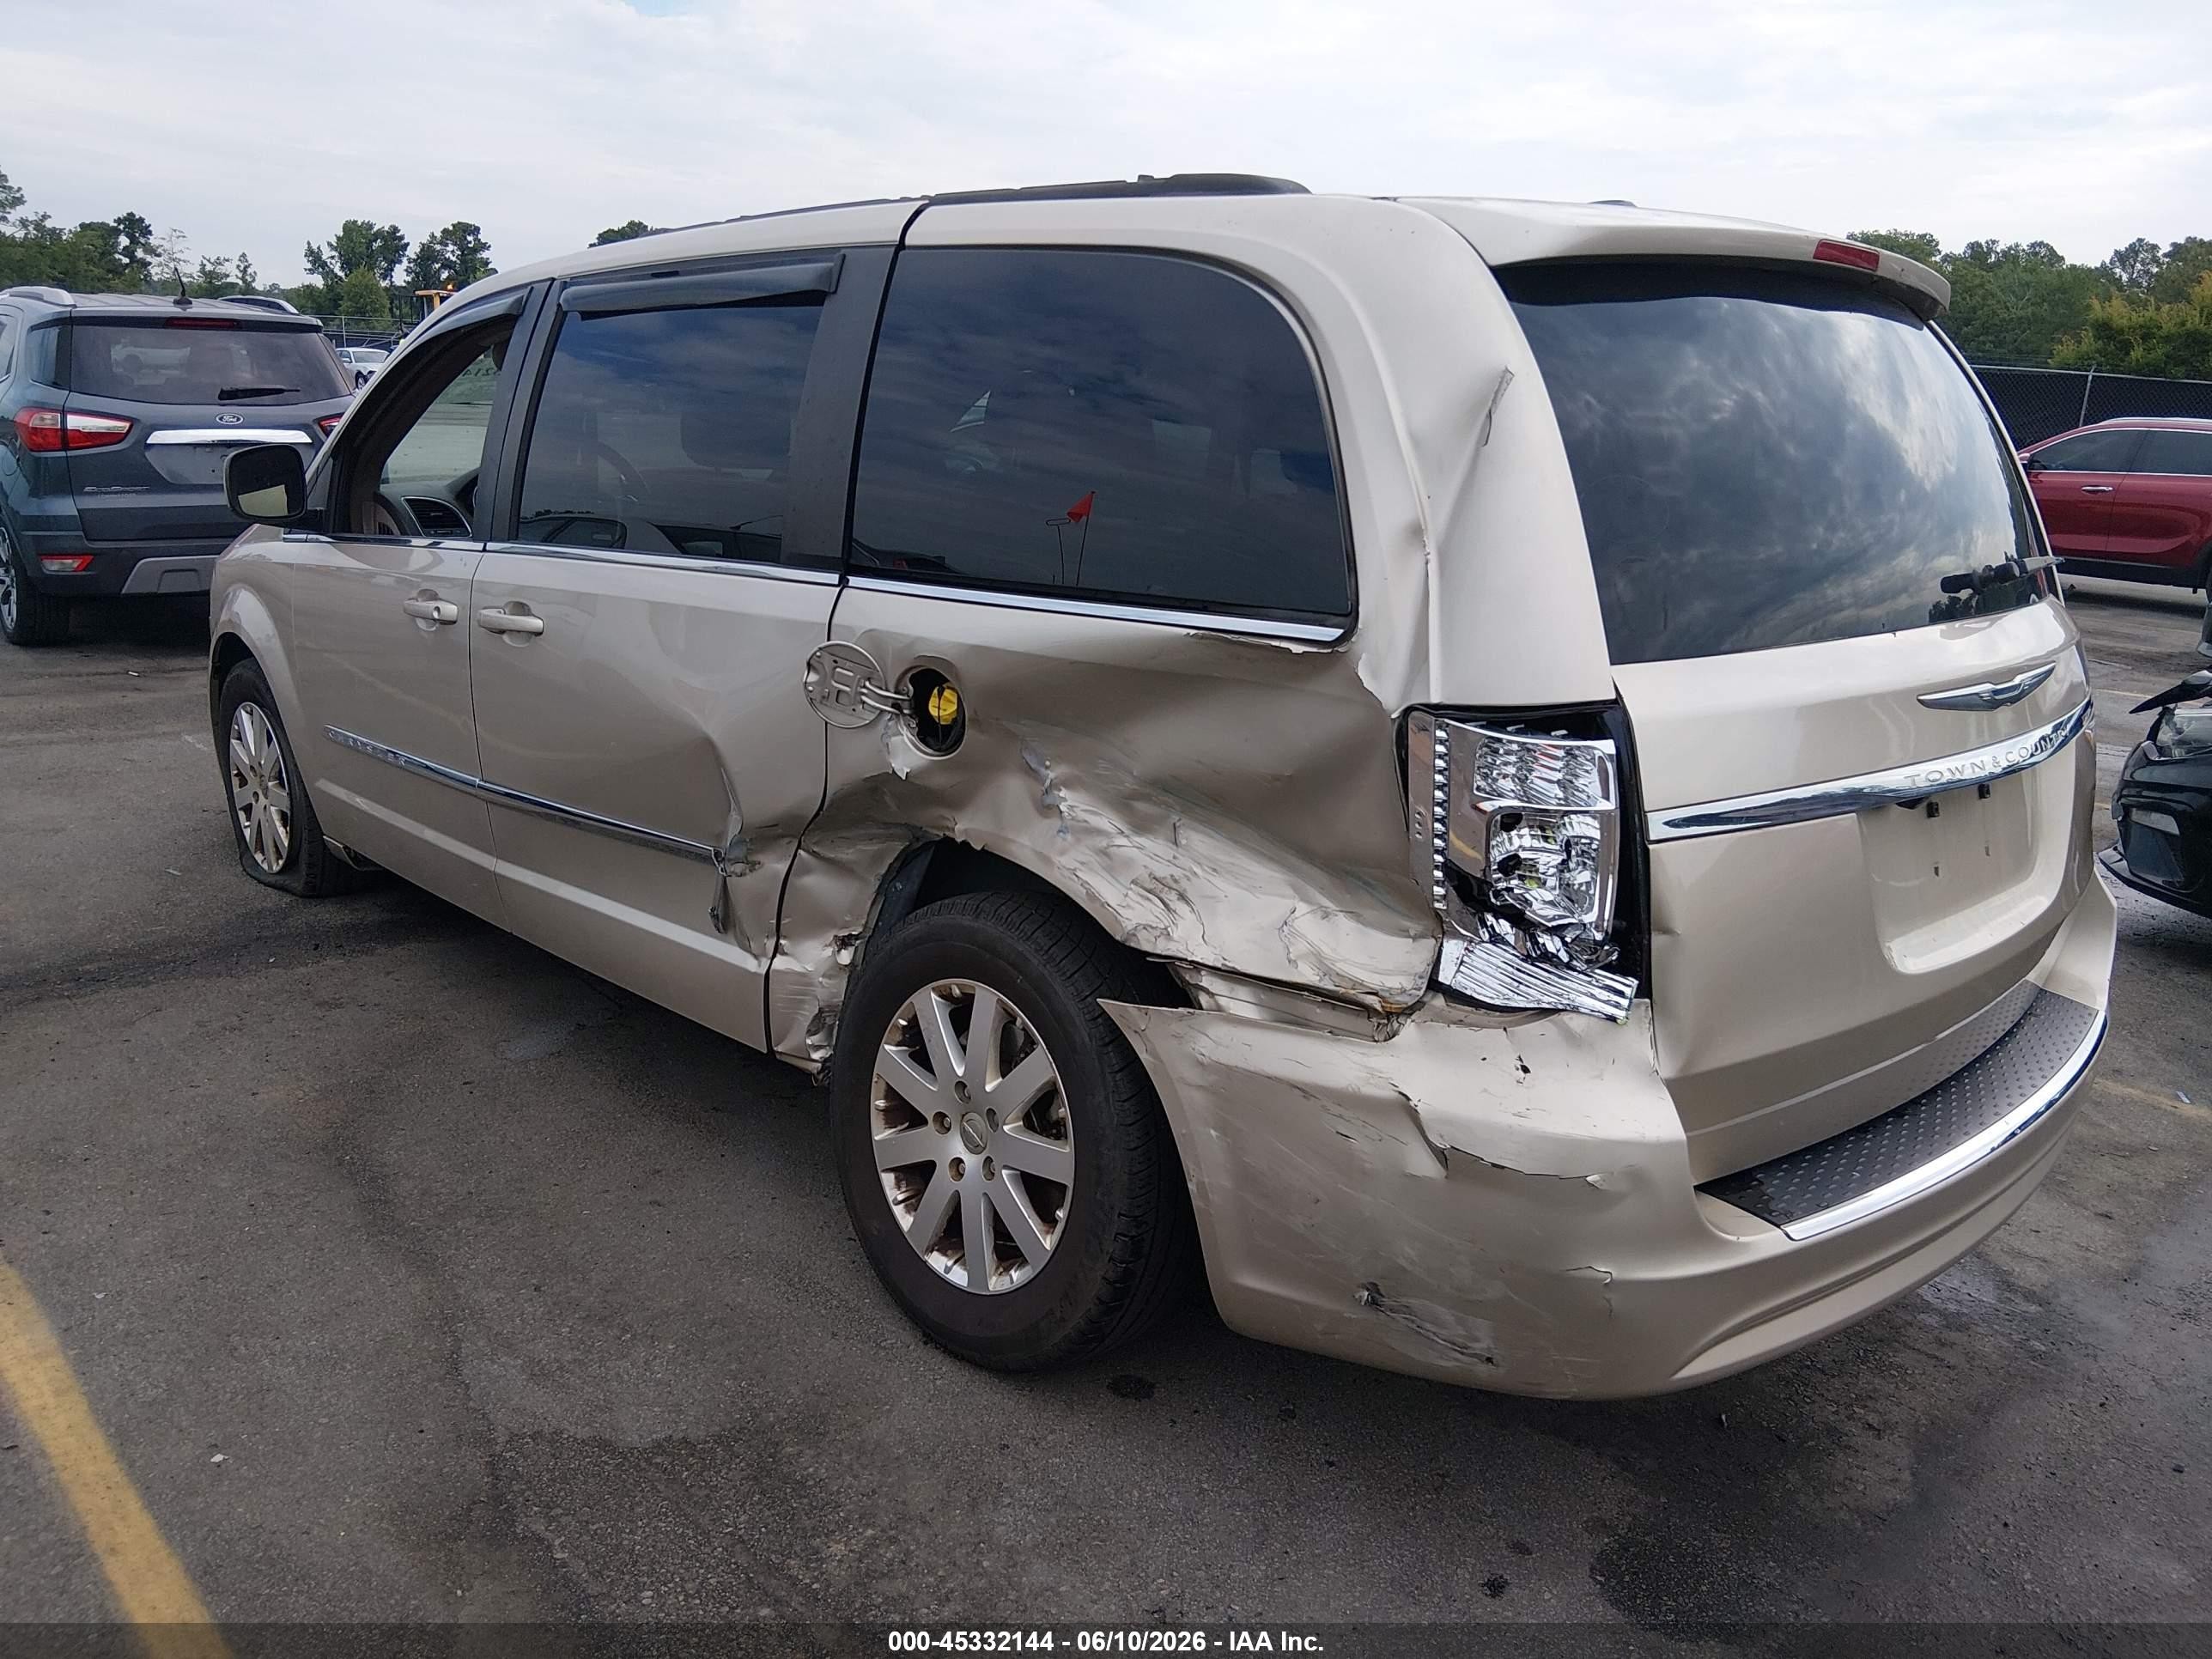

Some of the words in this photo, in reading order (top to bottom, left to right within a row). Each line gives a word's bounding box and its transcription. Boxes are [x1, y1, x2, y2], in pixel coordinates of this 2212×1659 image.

[1904, 759, 1986, 788] TOWN
[1991, 755, 2002, 769] &
[2005, 726, 2071, 763] COUNTRY
